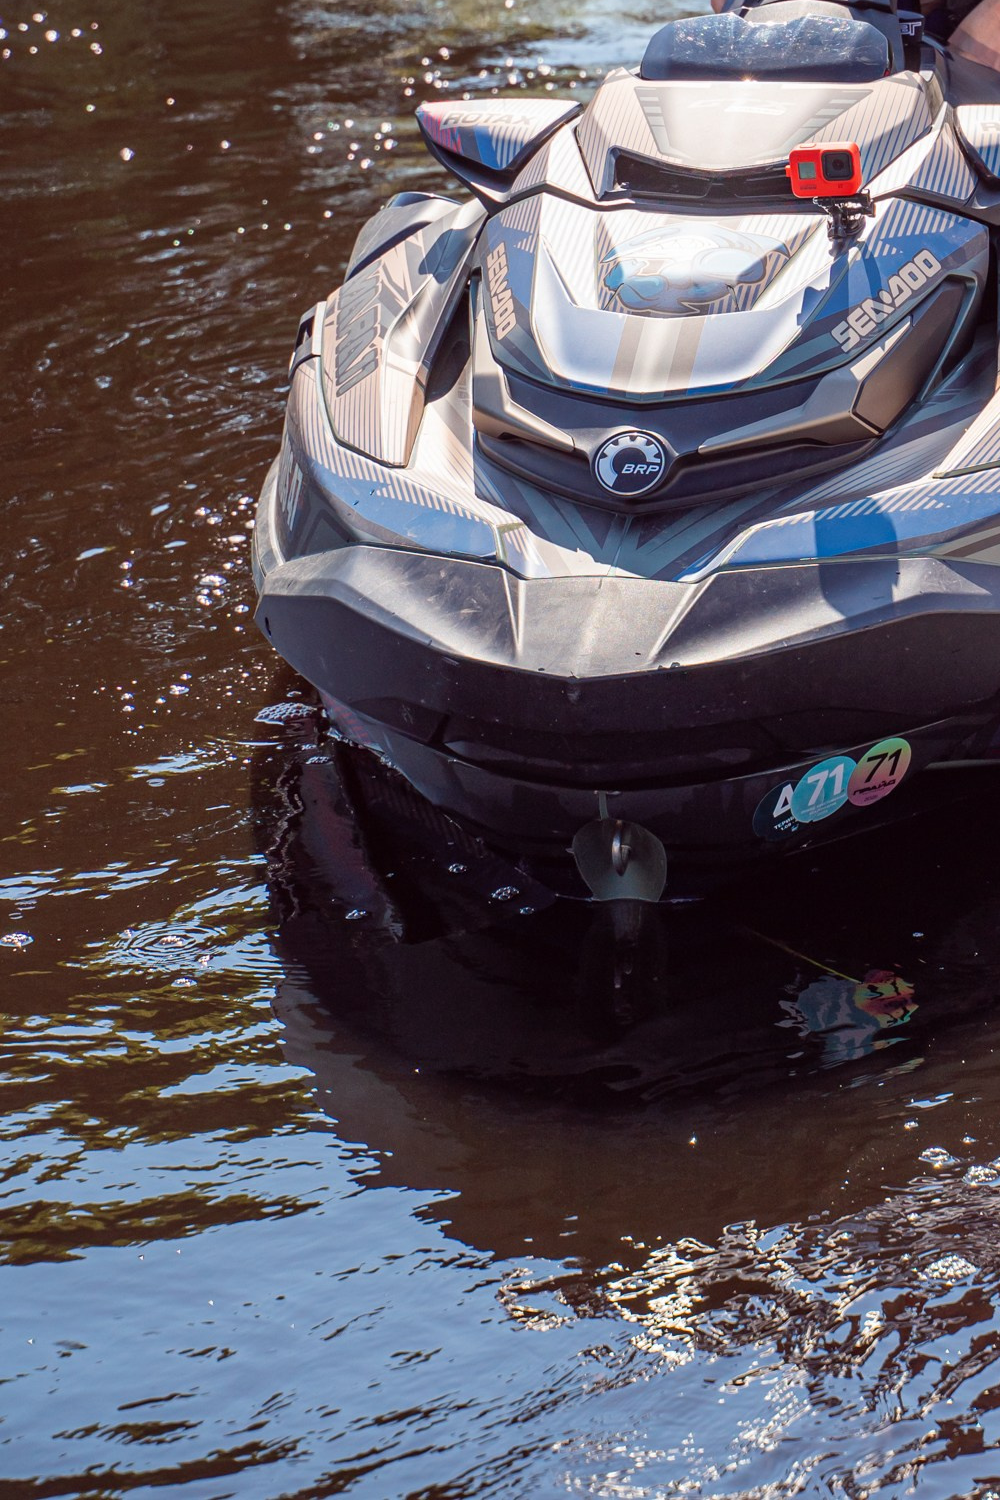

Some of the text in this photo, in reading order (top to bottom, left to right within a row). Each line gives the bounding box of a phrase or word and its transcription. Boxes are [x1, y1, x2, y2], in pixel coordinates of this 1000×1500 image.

[442, 112, 536, 126] ROTAX
[621, 463, 660, 475] BRP
[863, 747, 903, 784] 71
[806, 762, 845, 807] 71
